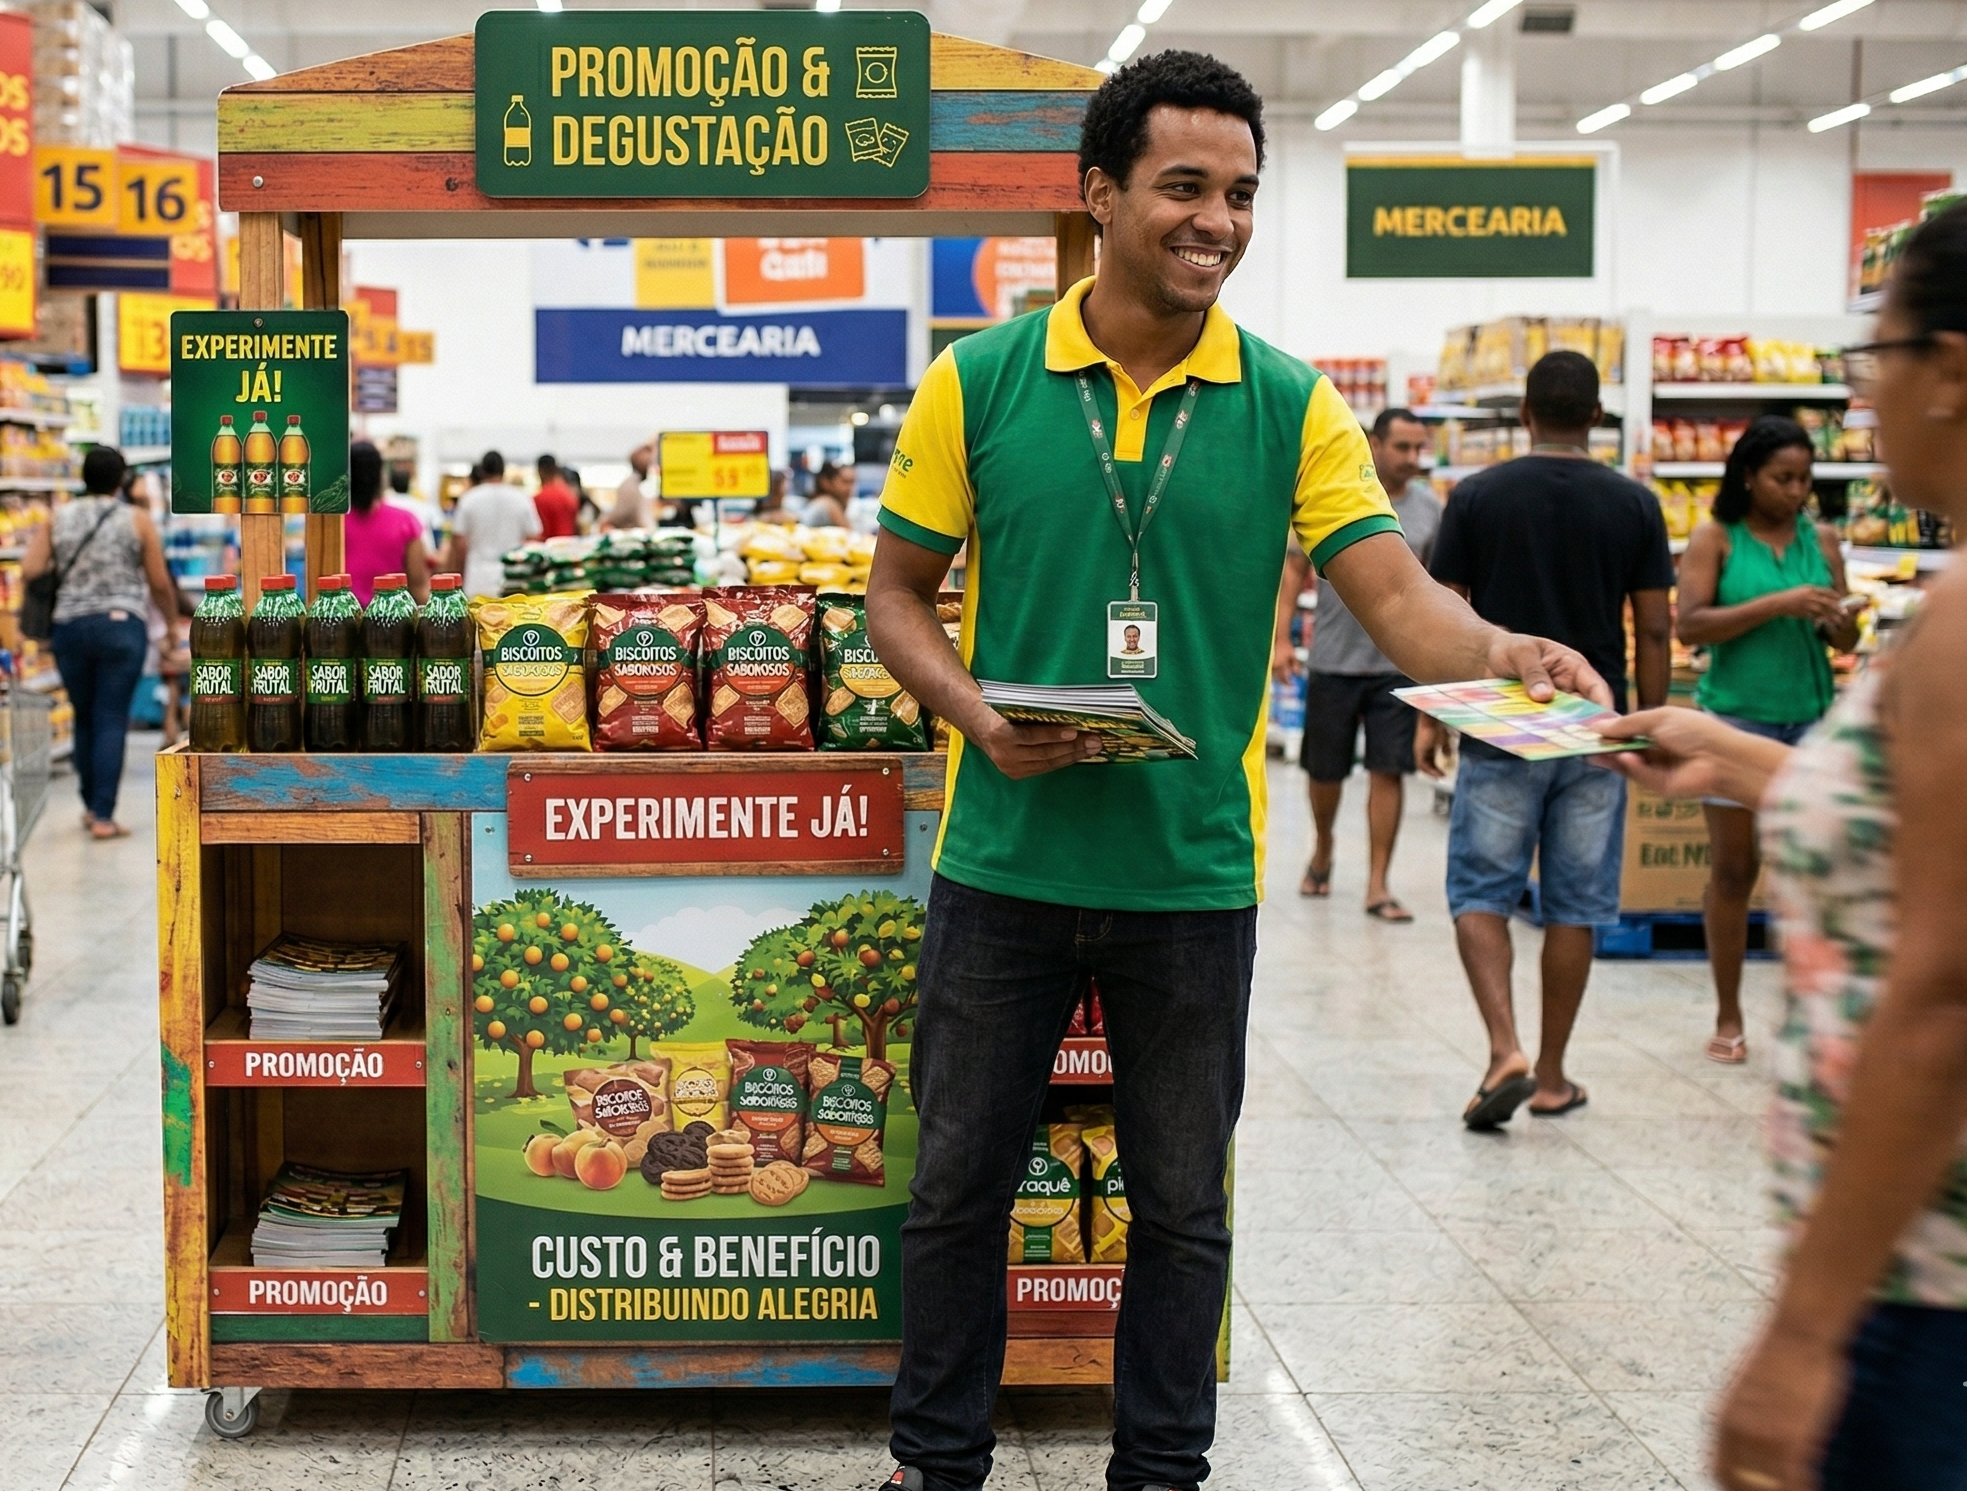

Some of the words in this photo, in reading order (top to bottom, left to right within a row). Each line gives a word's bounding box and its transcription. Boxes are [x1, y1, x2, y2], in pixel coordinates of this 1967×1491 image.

[552, 37, 788, 106] PROMOÇÃO
[803, 47, 830, 97] &
[553, 106, 829, 175] DEGUSTAÇÃO
[42, 163, 103, 211] 15
[125, 176, 187, 222] 16
[1373, 206, 1568, 238] MERCEARIA
[181, 334, 338, 359] EXPERIMENTE
[621, 325, 822, 358] MERCEARIA
[235, 362, 282, 403] JÁ!
[501, 646, 562, 661] BISCOITOS
[615, 646, 677, 662] BISCOITOS
[727, 646, 790, 661] BISCOITOS
[195, 680, 234, 694] FRUTAL
[196, 666, 231, 680] SABOR
[253, 679, 292, 694] FRUTAL
[255, 666, 289, 680] SABOR
[312, 665, 346, 680] SABOR
[367, 680, 405, 694] FRUTAL
[368, 665, 403, 680] SABOR
[545, 796, 798, 841] EXPERIMENTE
[810, 784, 869, 838] JÁ!
[245, 1047, 384, 1085] PROMOÇÃO
[532, 1235, 648, 1279] CUSTO
[658, 1239, 683, 1279] &
[694, 1227, 881, 1278] BENEFÍCIO
[249, 1275, 388, 1313] PROMOÇÃO
[550, 1286, 750, 1322] DISTRIBUINDO
[757, 1286, 879, 1321] ALEGRIA
